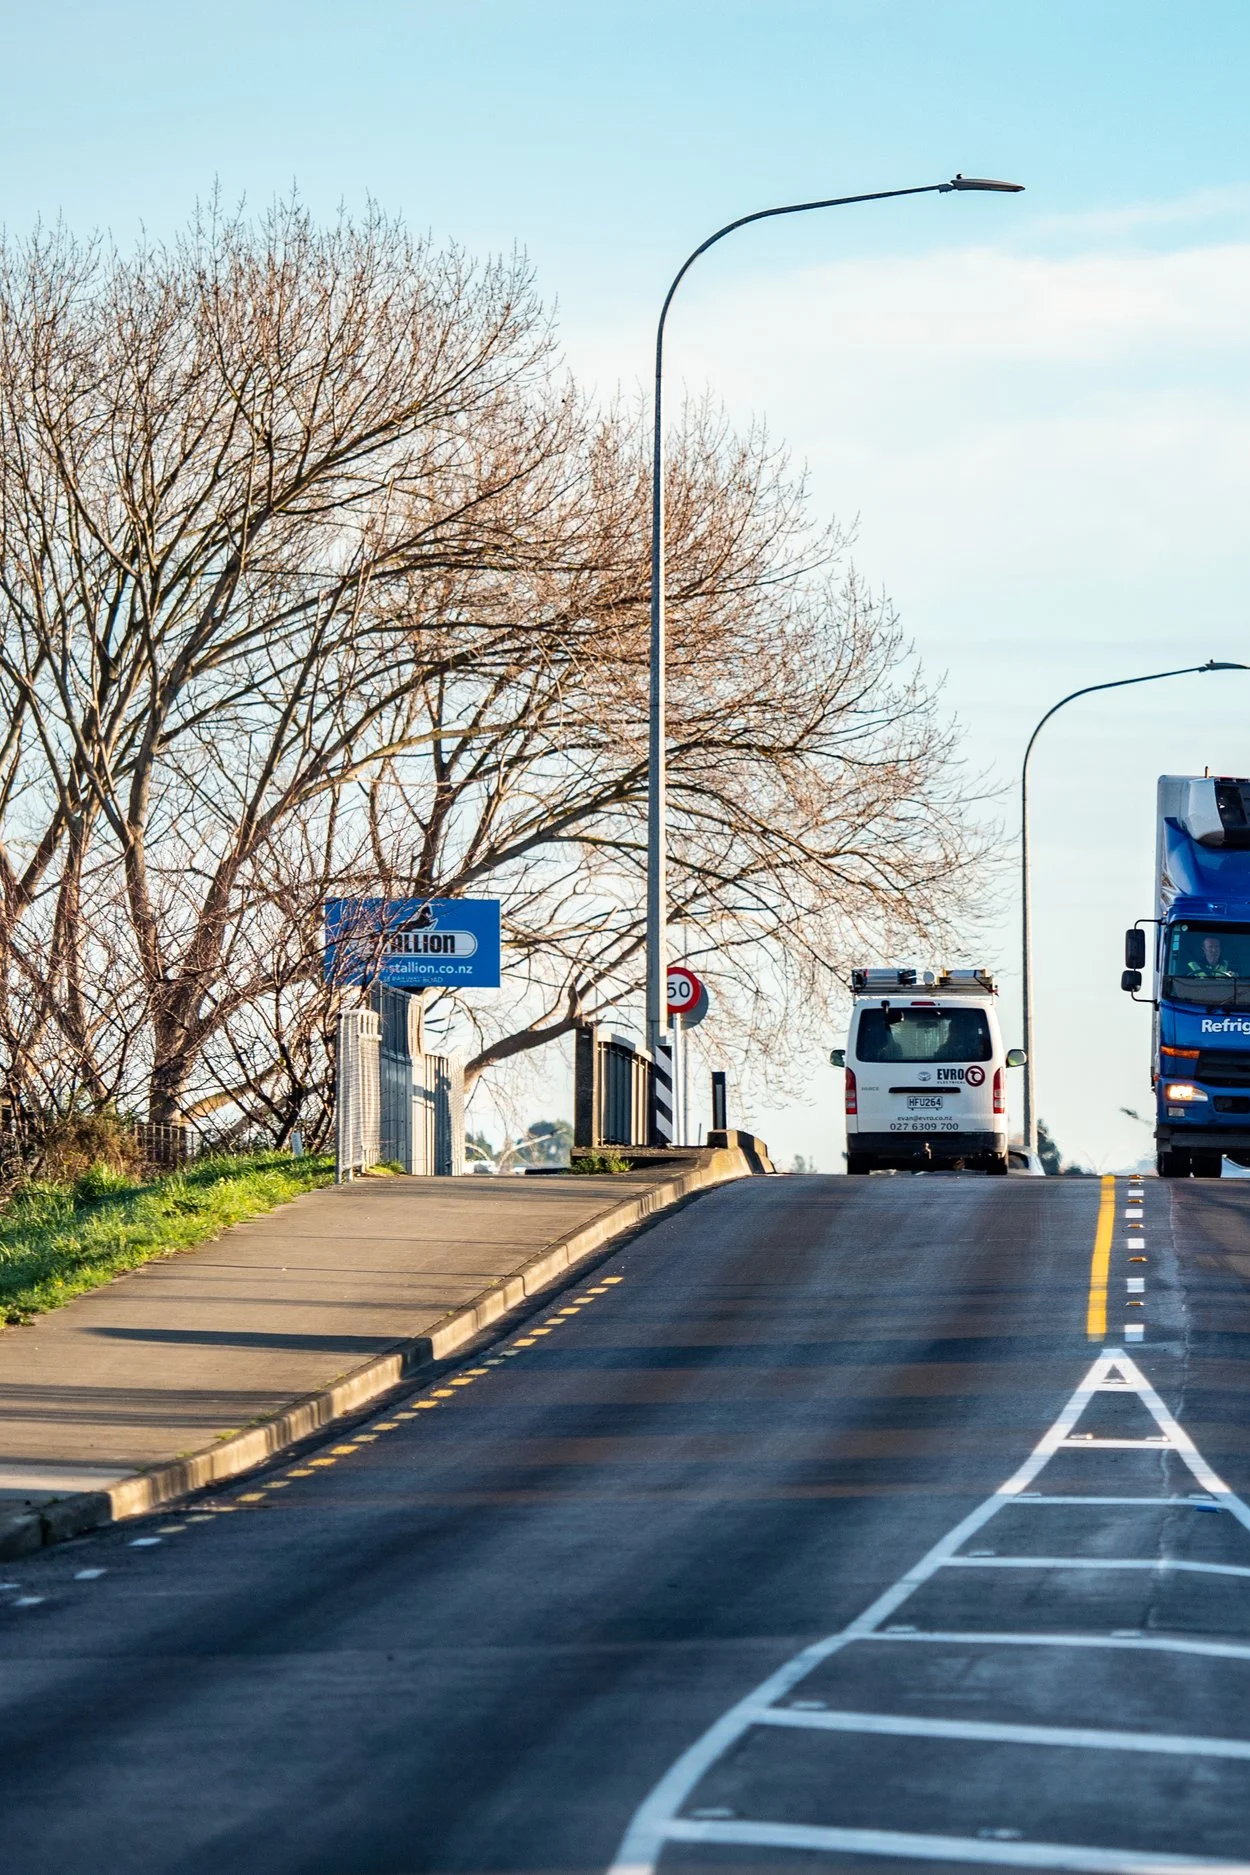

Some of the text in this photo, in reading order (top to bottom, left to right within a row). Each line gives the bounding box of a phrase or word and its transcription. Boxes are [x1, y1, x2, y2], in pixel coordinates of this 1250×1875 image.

[374, 934, 456, 953] TALLION
[667, 981, 690, 999] 50
[937, 1068, 965, 1080] EVRO
[909, 1098, 941, 1107] HFU264
[890, 1123, 959, 1131] 027 6309 700
